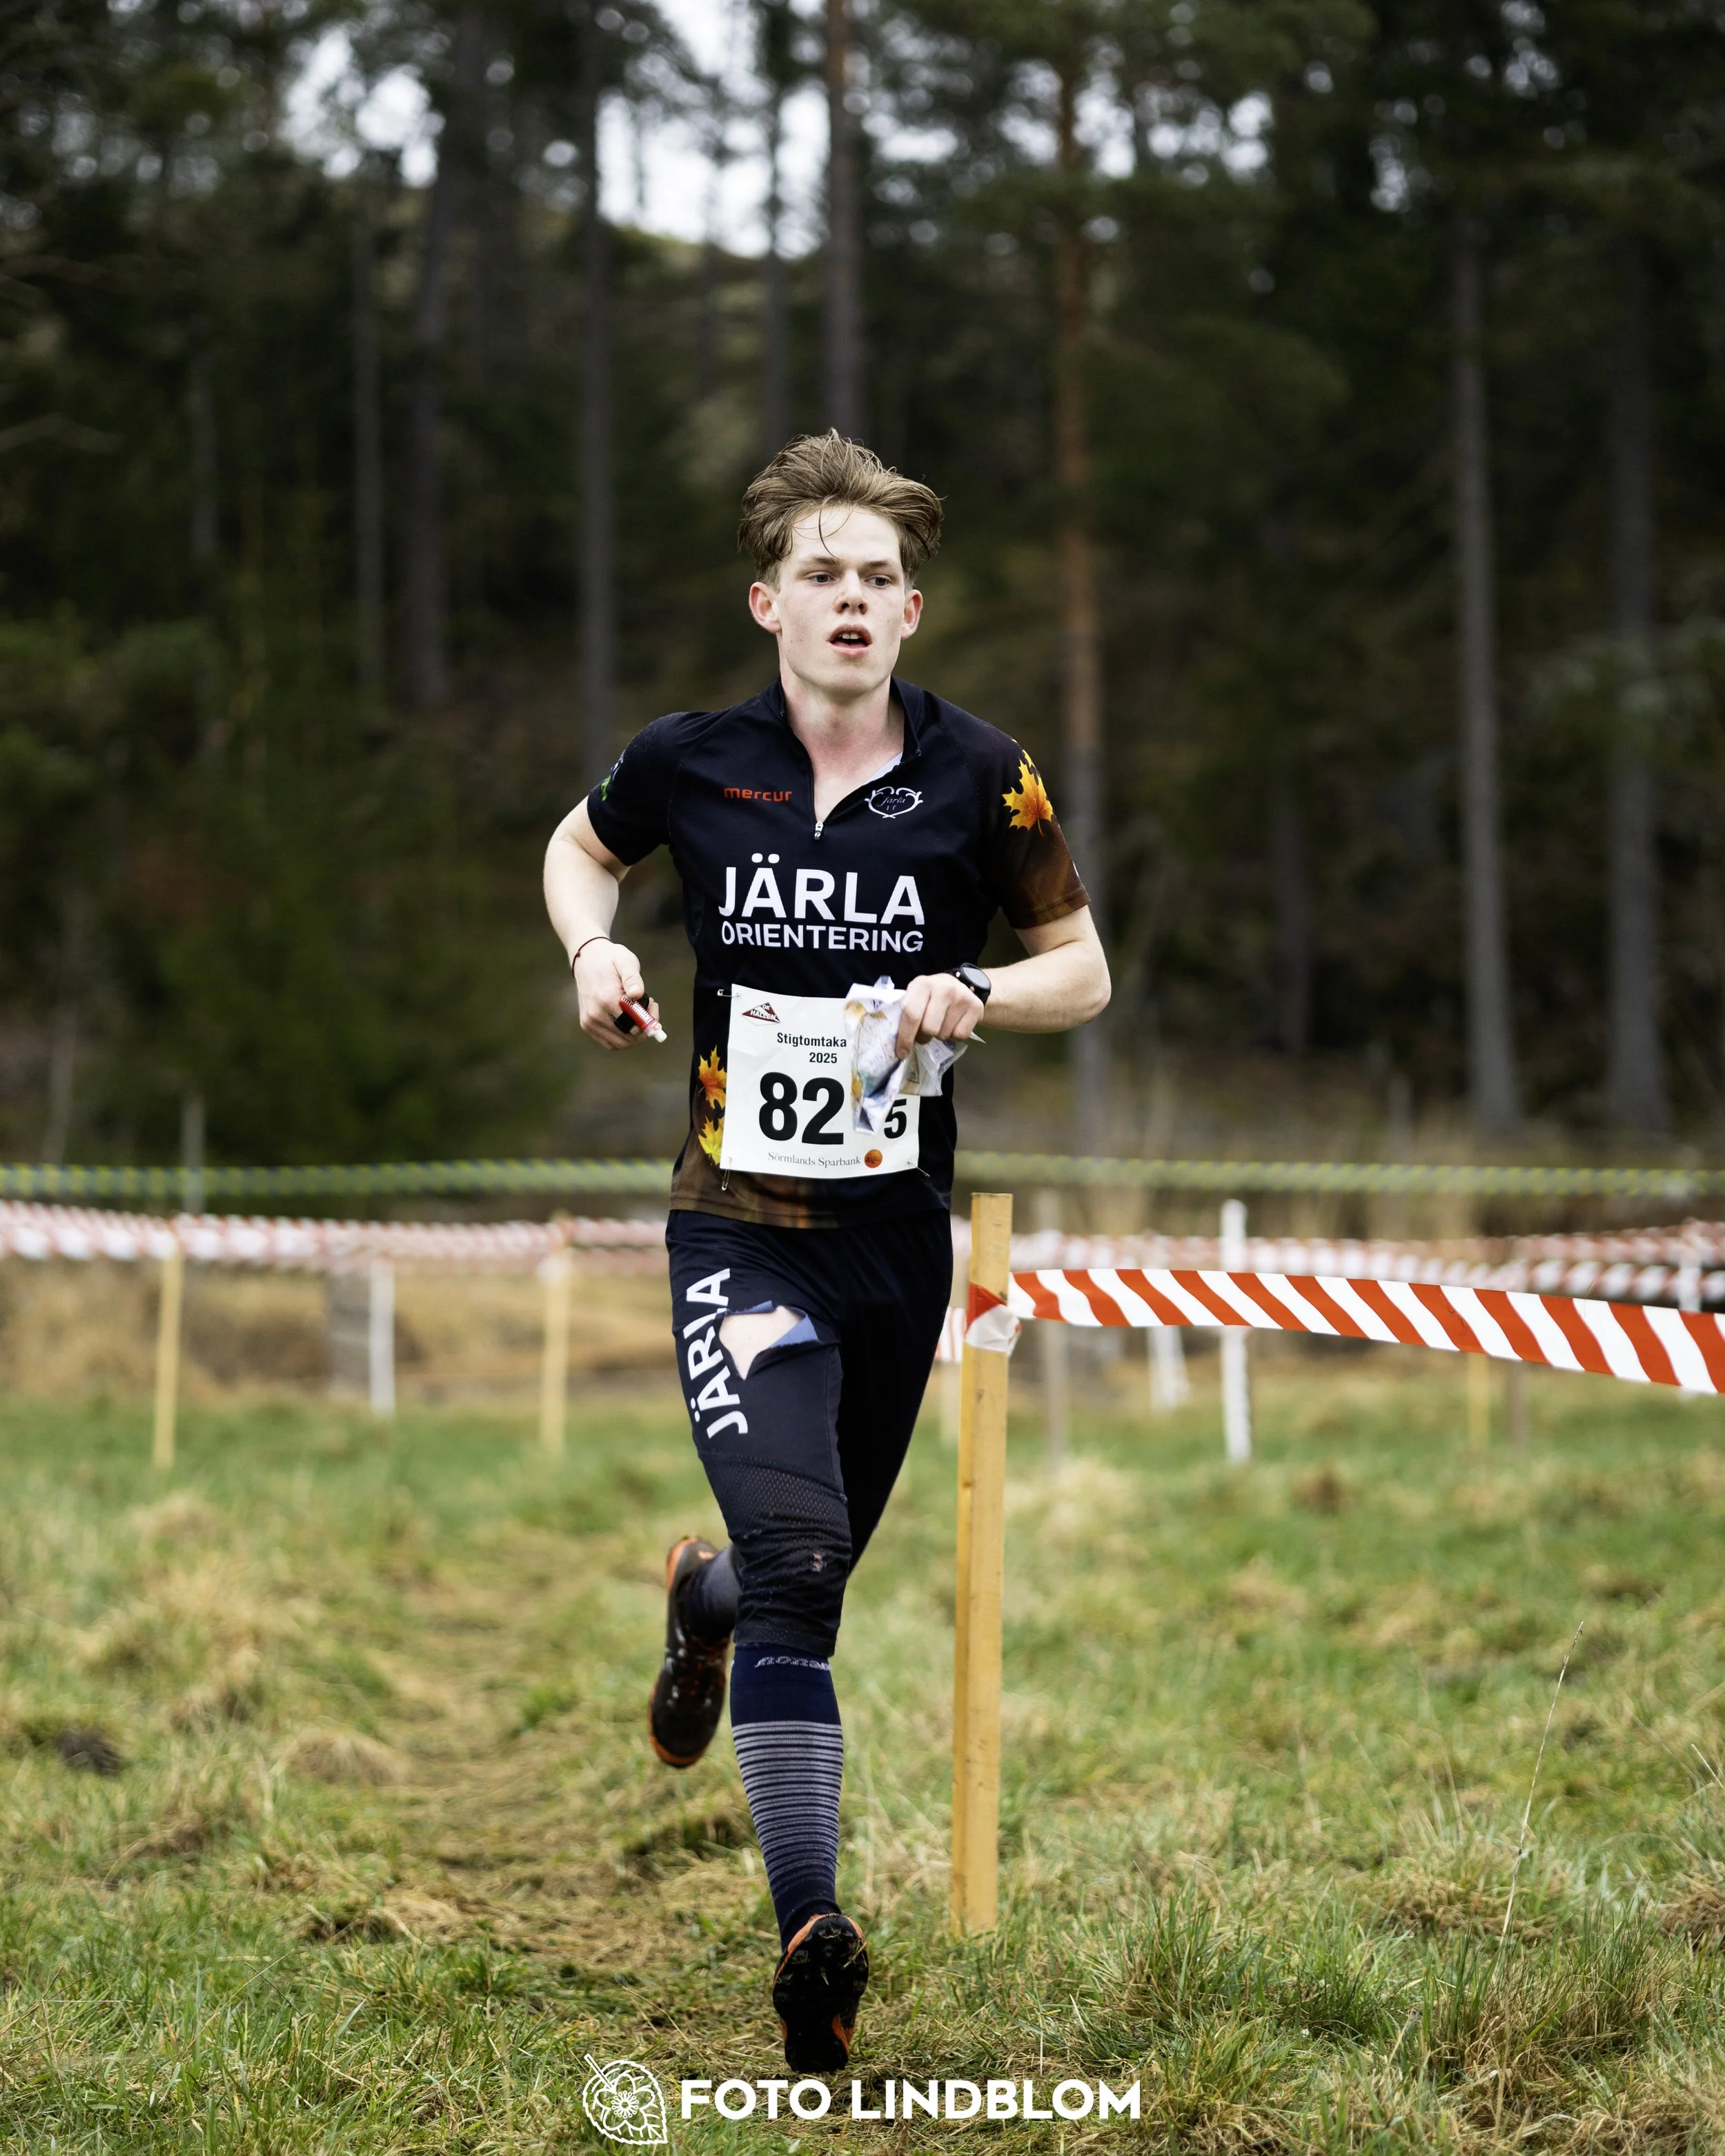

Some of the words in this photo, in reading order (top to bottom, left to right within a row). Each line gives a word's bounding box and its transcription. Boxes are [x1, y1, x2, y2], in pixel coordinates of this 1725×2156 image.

[724, 787, 792, 802] mercur
[718, 853, 925, 925] JÄRLA
[721, 920, 924, 953] ORIENTERING
[776, 1032, 847, 1047] Stigtomtaka
[809, 1052, 838, 1064] 2025
[767, 1151, 816, 1166] Sörmlands
[818, 1155, 862, 1169] Sparbank
